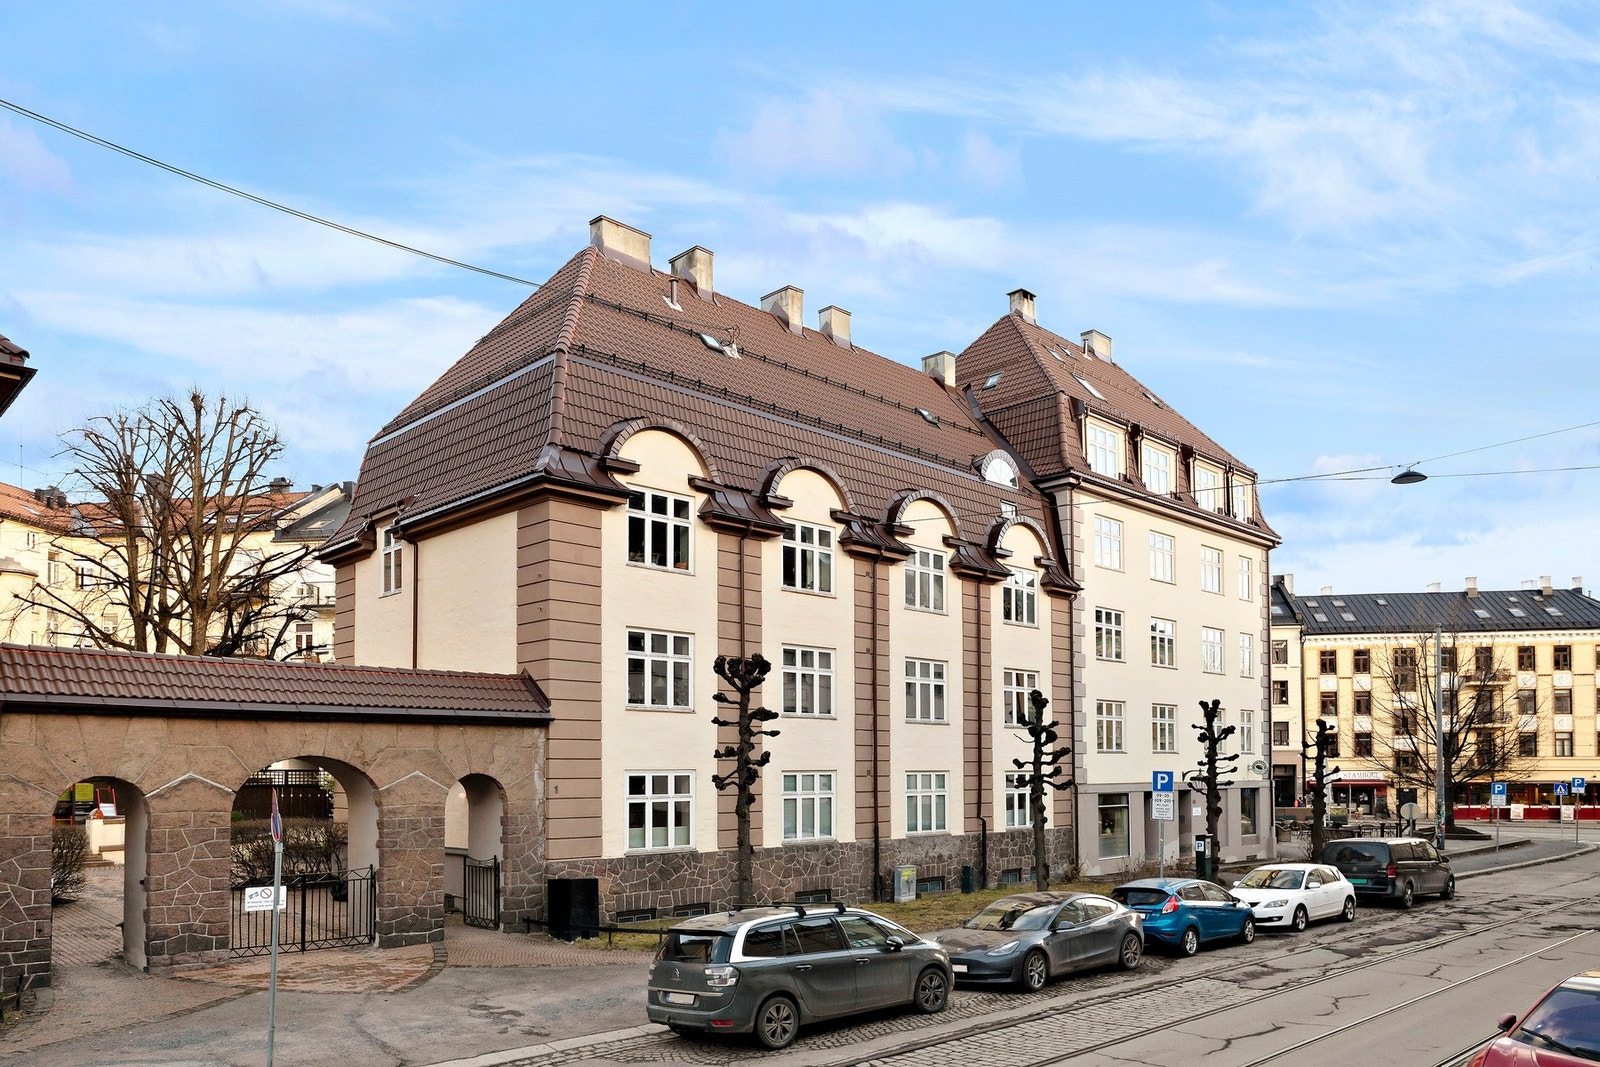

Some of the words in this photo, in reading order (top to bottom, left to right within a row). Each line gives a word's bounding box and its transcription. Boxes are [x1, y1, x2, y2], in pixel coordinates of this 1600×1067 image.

[1157, 773, 1168, 789] P
[1575, 778, 1582, 786] P
[1495, 784, 1503, 793] P
